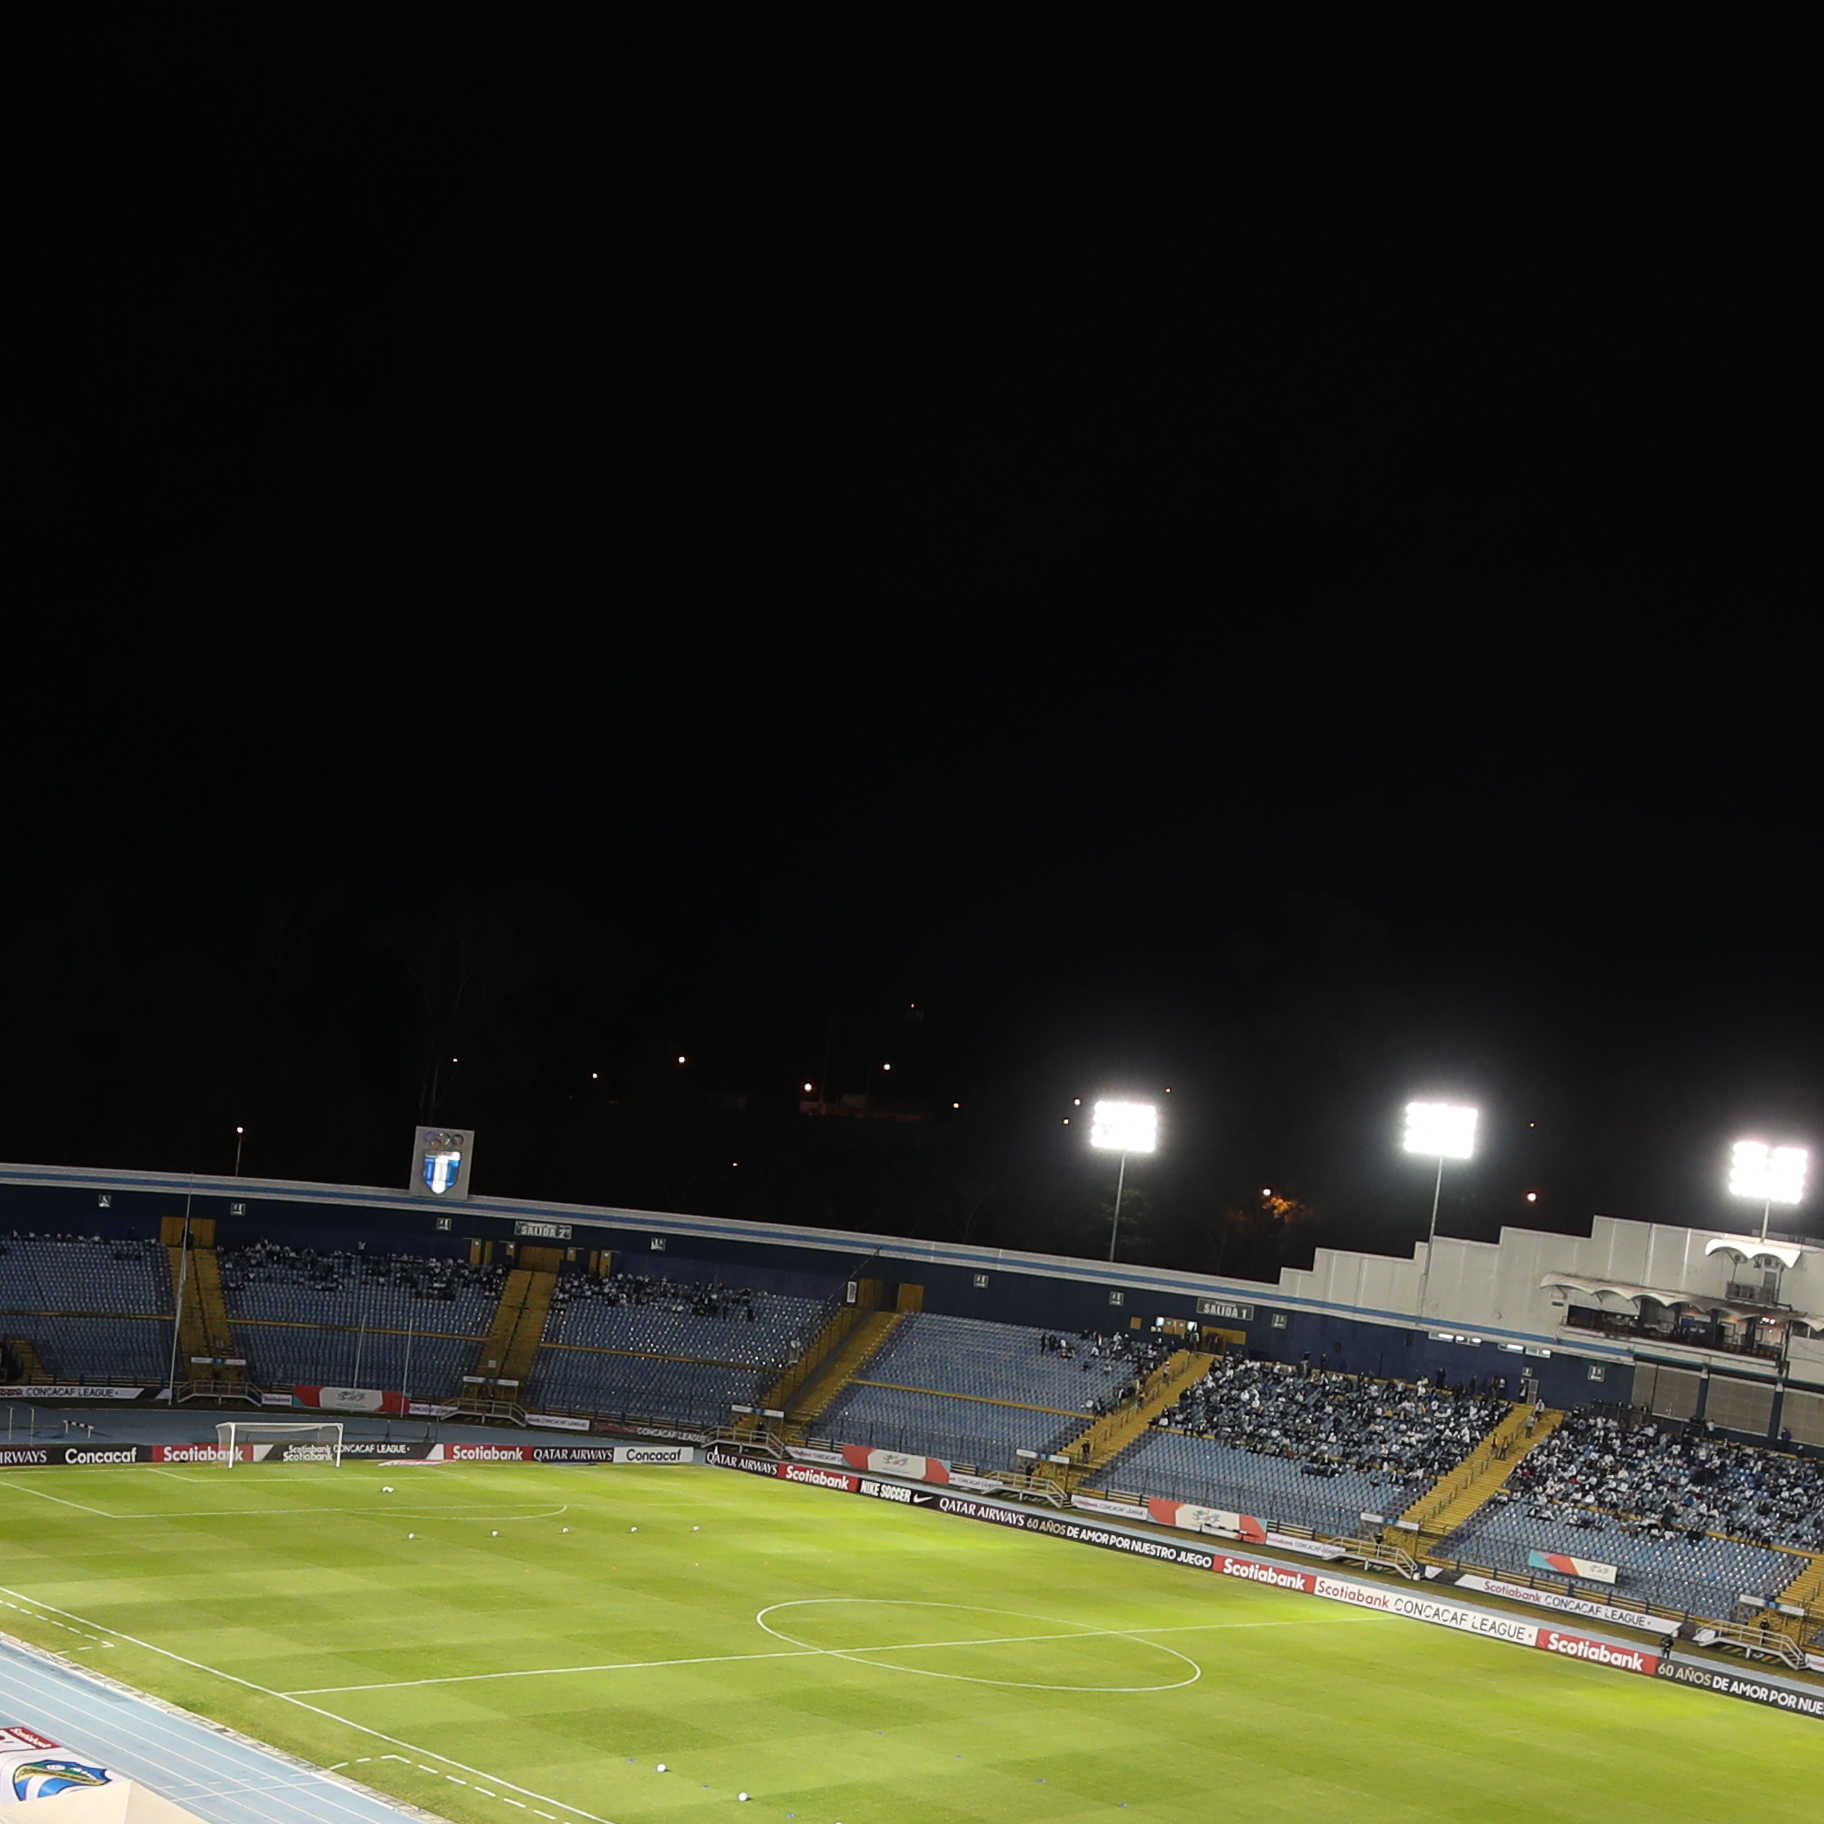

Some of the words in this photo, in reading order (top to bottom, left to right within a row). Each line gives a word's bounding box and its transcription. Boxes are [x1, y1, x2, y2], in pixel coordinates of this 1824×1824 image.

[520, 1225, 556, 1238] SALIDA
[1203, 1303, 1239, 1318] SALIDA
[1241, 1308, 1248, 1319] 1
[25, 1387, 74, 1398] CONCACAF
[75, 1387, 114, 1398] LEAGUE
[636, 1426, 677, 1442] CONCACAF
[65, 1447, 137, 1464] Concacaf
[163, 1444, 244, 1462] Scotiabank
[376, 1445, 407, 1455] LEAGUE
[452, 1445, 524, 1462] Scotiabank
[533, 1449, 568, 1462] QATAR
[568, 1449, 613, 1462] AIRWAYS
[626, 1448, 682, 1462] Concacaf
[706, 1451, 737, 1468] QATAR
[738, 1458, 778, 1475] AIRWAYS
[785, 1465, 850, 1490] Scotiabank
[860, 1479, 880, 1496] NIKE
[879, 1482, 912, 1503] SOCCER
[939, 1497, 976, 1516] QATAR
[977, 1506, 1025, 1527] AIRWAYS
[1026, 1517, 1038, 1529] 60
[1038, 1517, 1066, 1535] AÑOS
[1066, 1525, 1080, 1538] DE
[1080, 1528, 1109, 1545] AMOR
[1109, 1534, 1131, 1549] POR
[1131, 1540, 1177, 1560] NUESTRO
[1177, 1549, 1212, 1568] JUEGO
[1223, 1558, 1306, 1590] Scotiabank
[1317, 1580, 1389, 1608] Scotiabank
[1395, 1598, 1469, 1625] CONCACAF
[1471, 1615, 1526, 1640] LEAGUE
[1483, 1580, 1542, 1602] Scotiabank
[1544, 1595, 1603, 1616] CONCACAF
[1604, 1607, 1647, 1626] LEAGUE
[1547, 1632, 1644, 1671] Scotiabank
[1657, 1662, 1674, 1677] 60
[1675, 1665, 1712, 1687] AÑOS
[1712, 1676, 1729, 1691] DE
[1729, 1680, 1769, 1701] AMOR
[1768, 1689, 1797, 1708] POR
